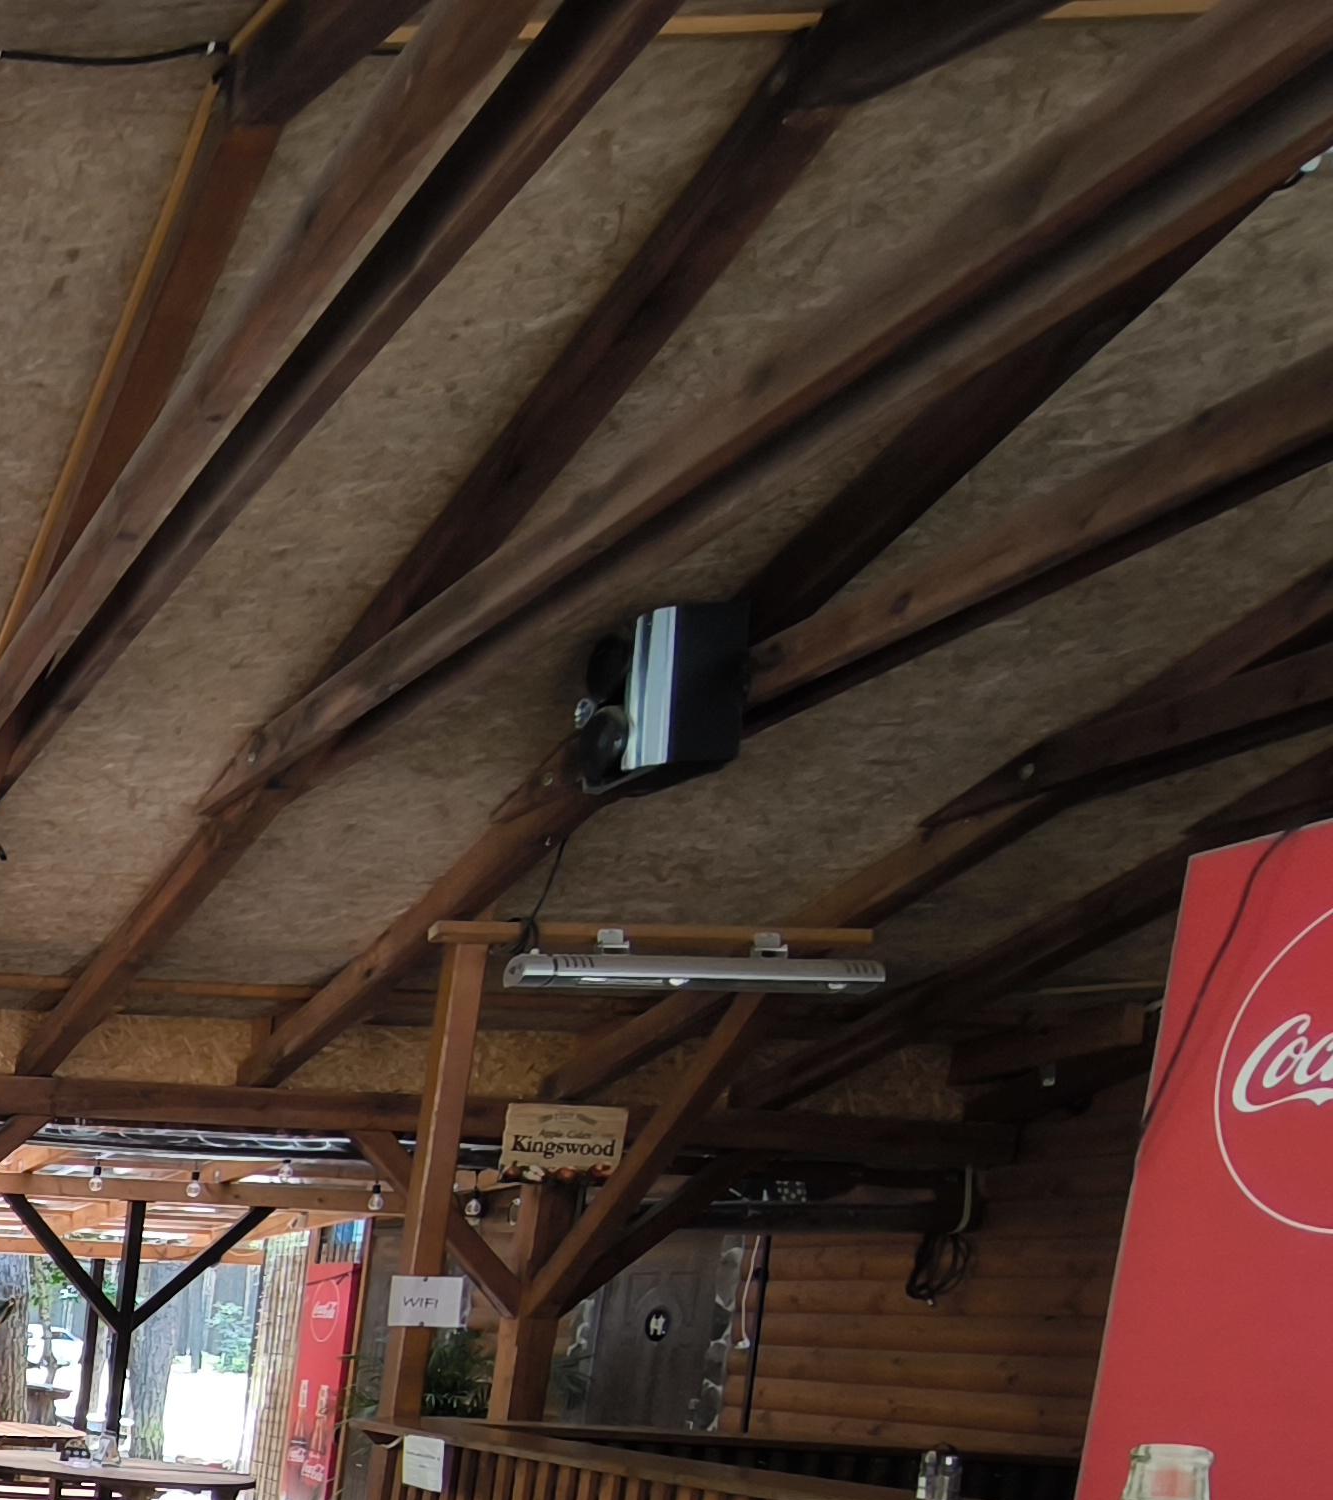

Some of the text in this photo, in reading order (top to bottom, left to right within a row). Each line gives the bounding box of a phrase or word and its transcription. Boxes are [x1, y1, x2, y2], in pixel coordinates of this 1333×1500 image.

[1232, 1013, 1333, 1113] Coc
[511, 1134, 616, 1160] Kingswood
[403, 1296, 439, 1310] WIFI
